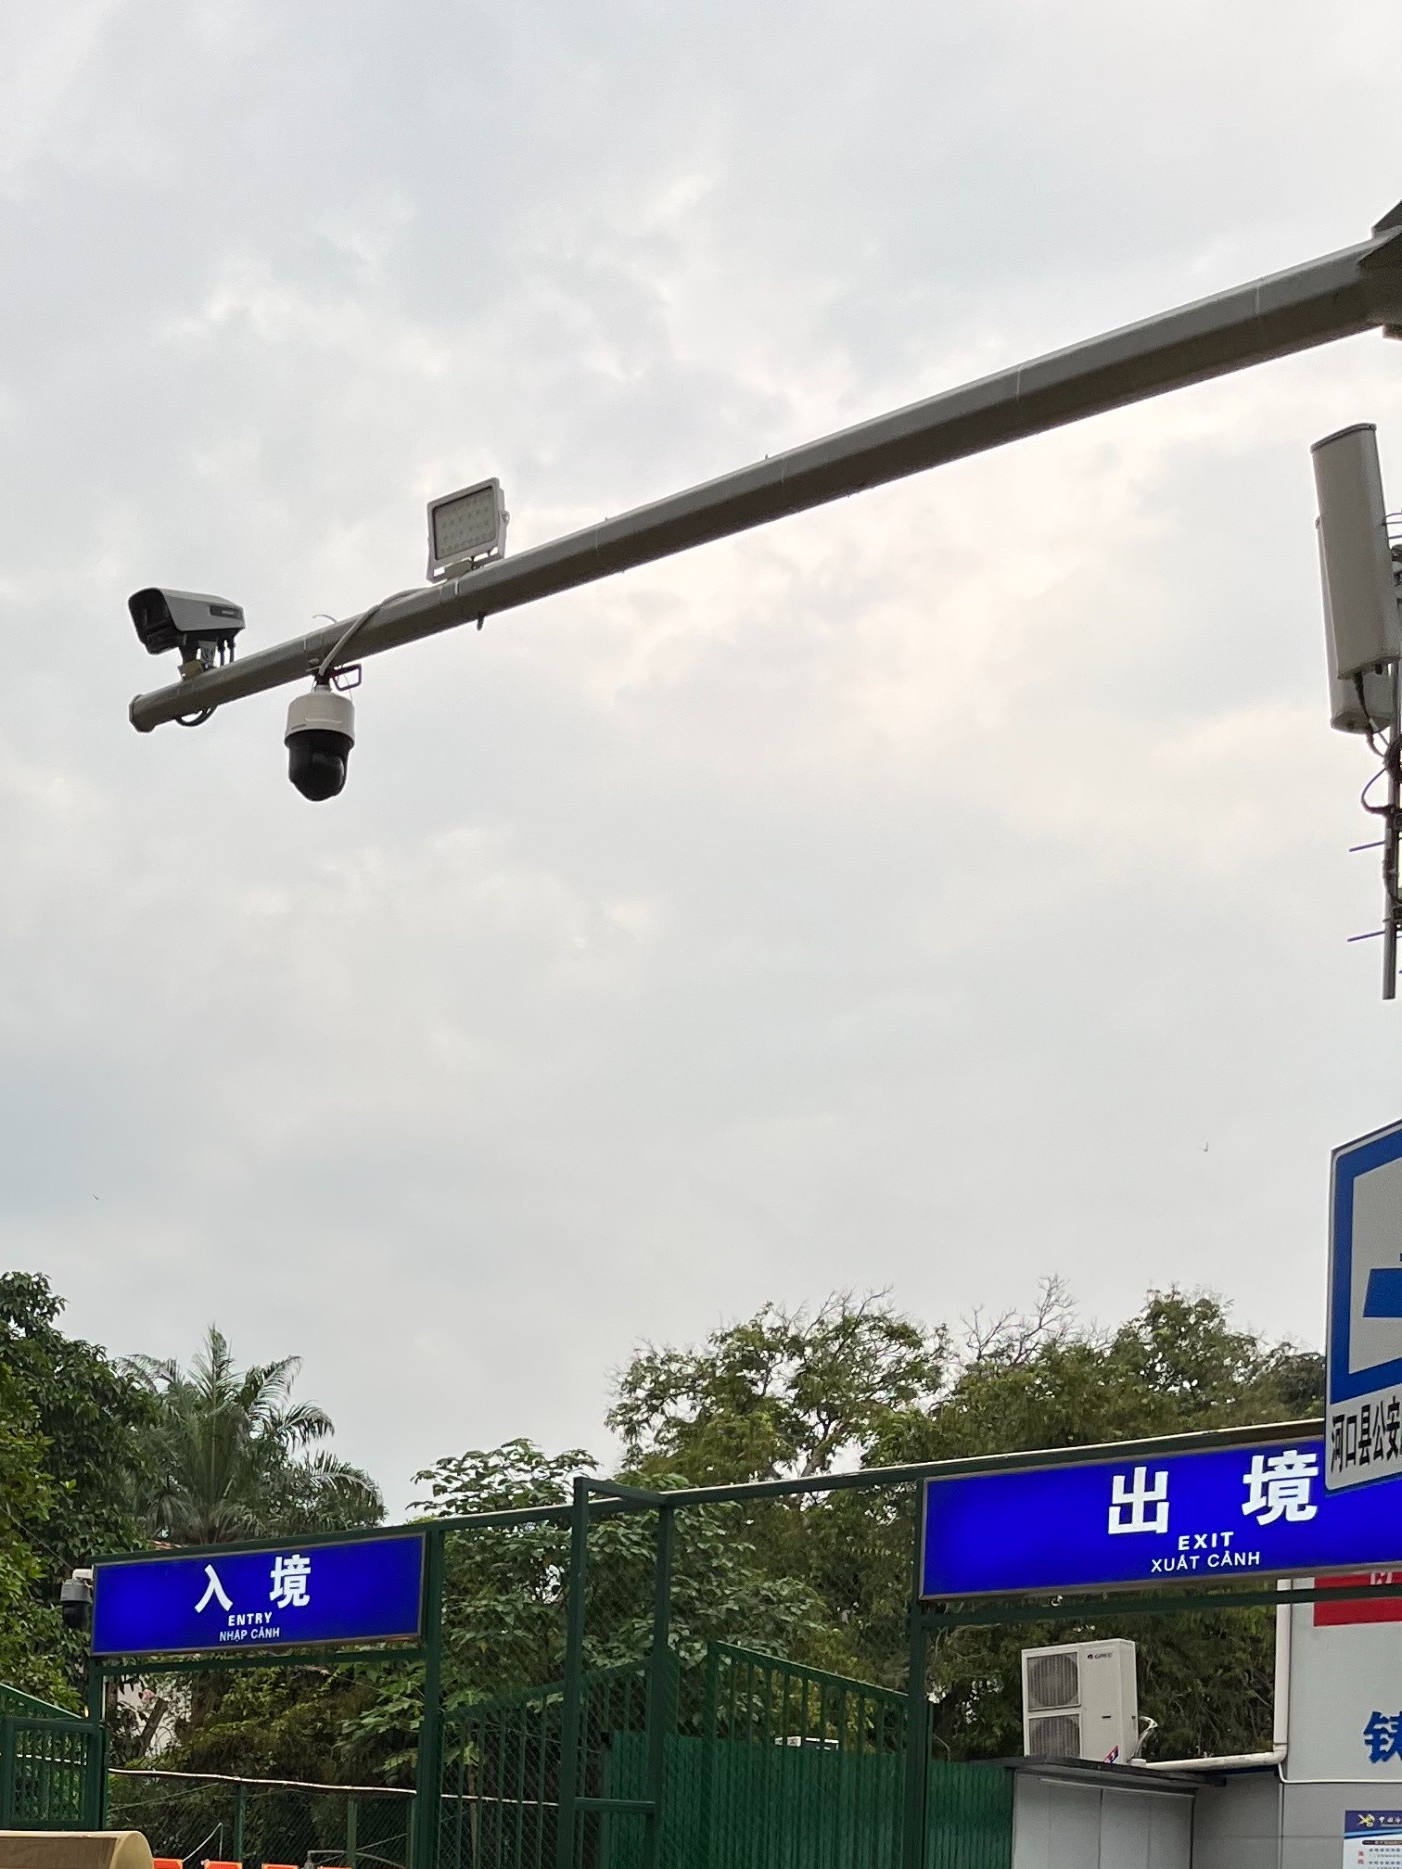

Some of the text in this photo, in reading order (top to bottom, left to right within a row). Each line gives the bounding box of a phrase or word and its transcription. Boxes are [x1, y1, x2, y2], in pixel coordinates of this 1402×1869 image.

[1331, 1396, 1402, 1473] 河口县公安
[1108, 1450, 1319, 1535] 出境
[1178, 1531, 1234, 1551] EXIT
[194, 1554, 311, 1613] 入境
[228, 1611, 272, 1626] ENTRY
